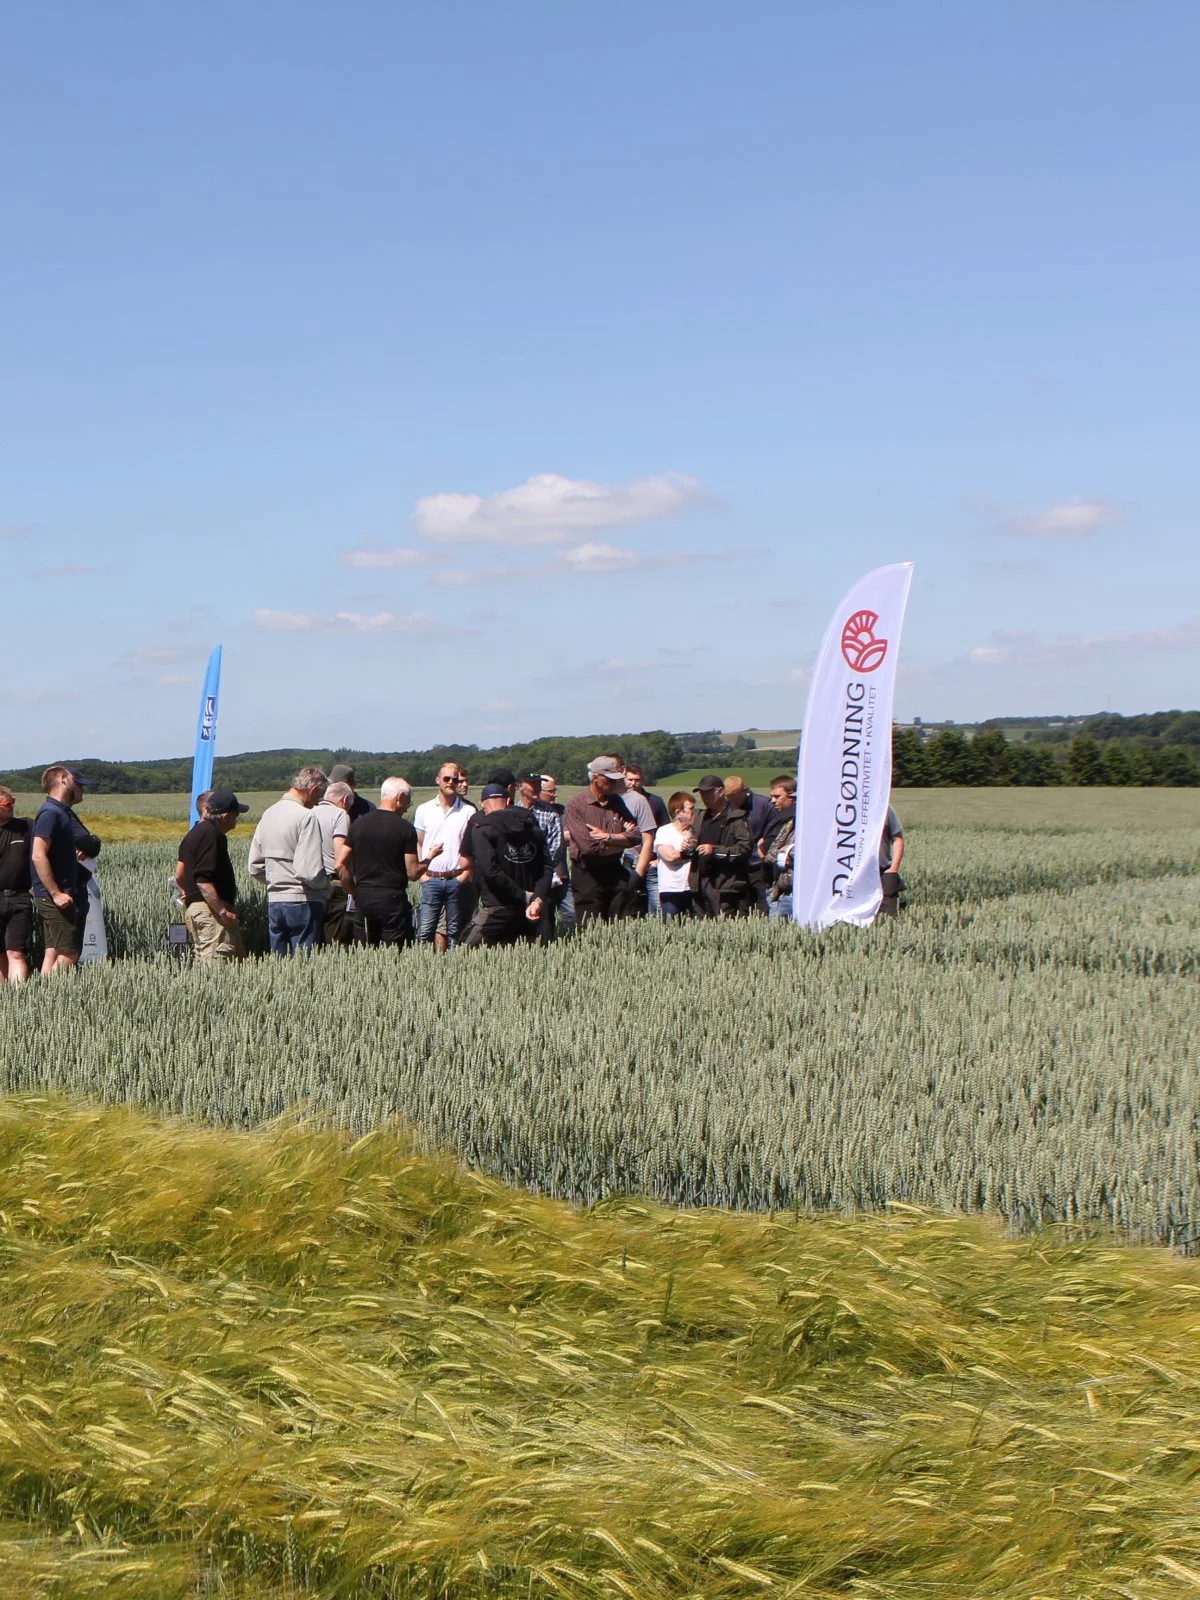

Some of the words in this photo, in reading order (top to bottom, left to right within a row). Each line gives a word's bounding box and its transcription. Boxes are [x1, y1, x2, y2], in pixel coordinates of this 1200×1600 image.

[866, 686, 876, 737] KVALITET
[832, 682, 865, 897] DANGØDNING
[861, 749, 872, 825] EFFEKTIVITET
